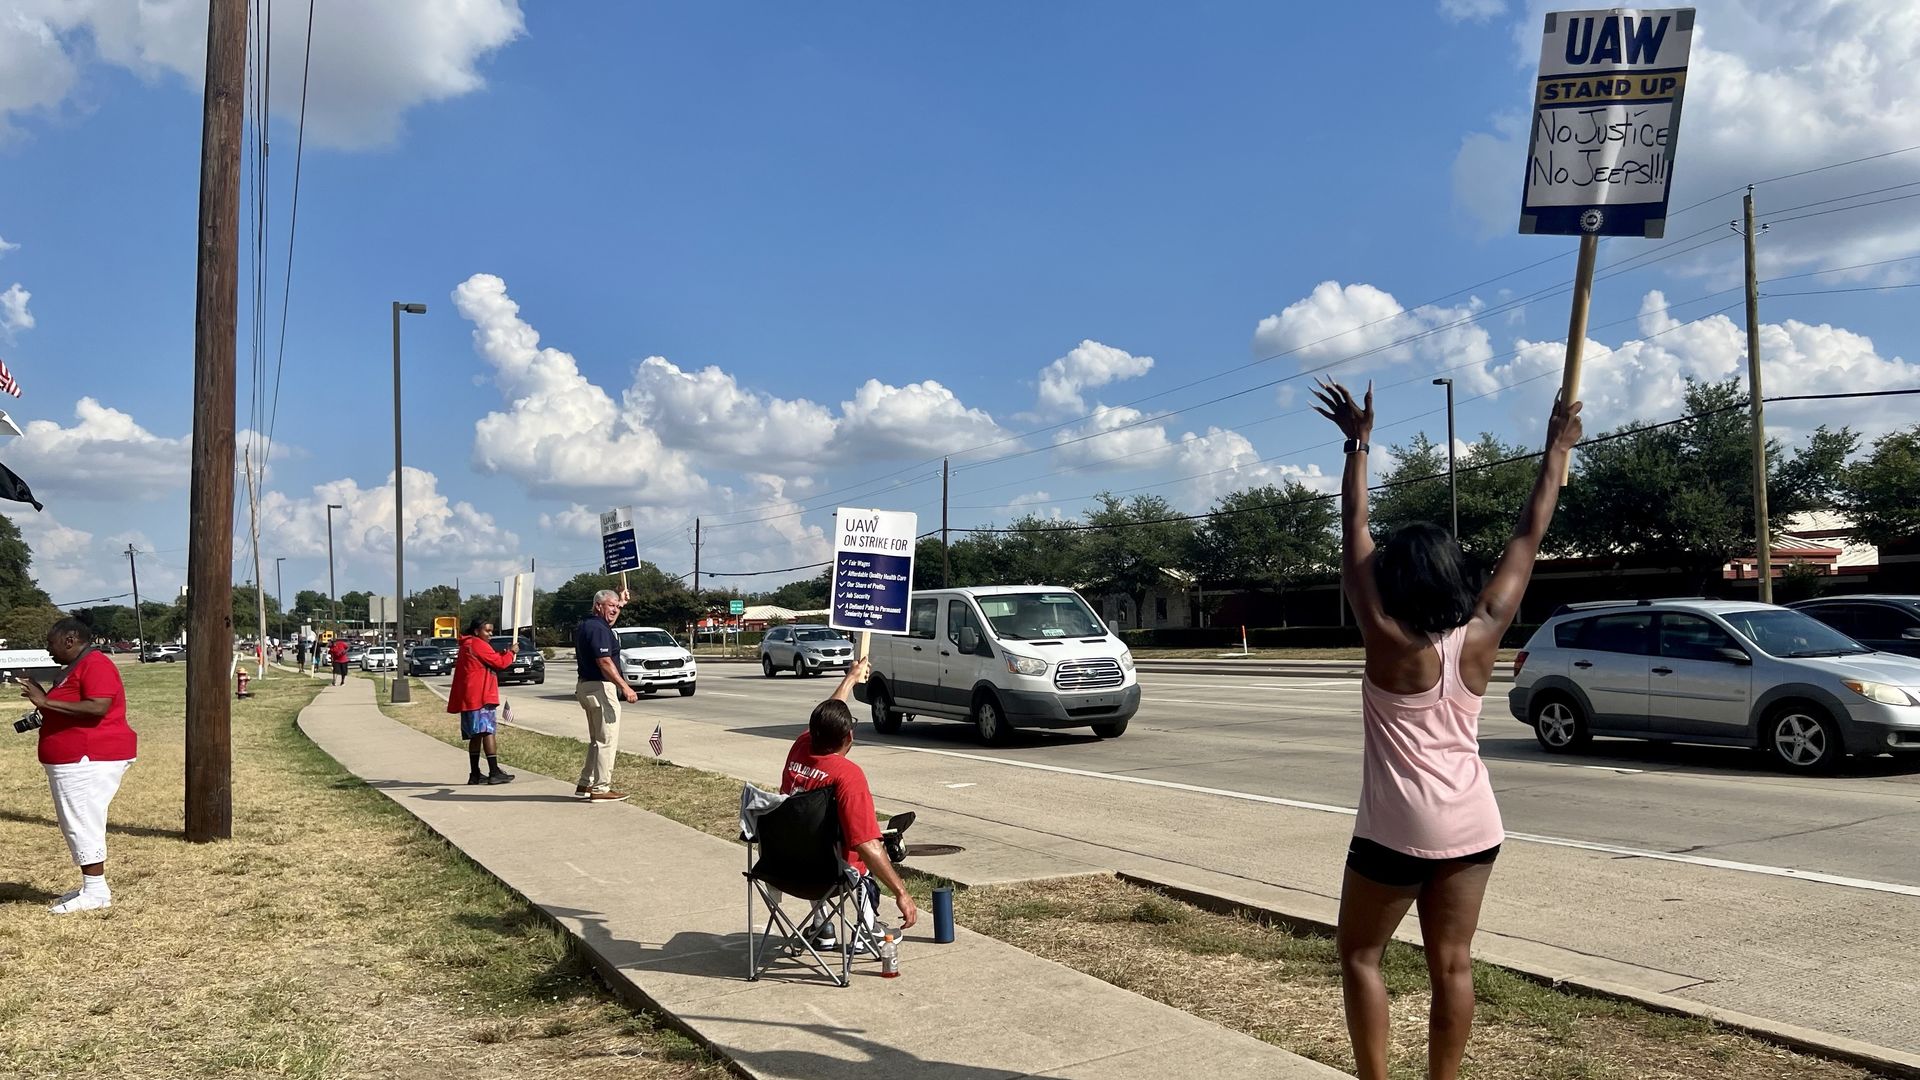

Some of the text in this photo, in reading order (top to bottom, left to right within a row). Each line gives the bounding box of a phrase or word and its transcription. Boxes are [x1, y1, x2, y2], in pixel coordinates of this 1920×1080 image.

[1565, 16, 1671, 65] UAW
[1543, 77, 1677, 100] STAND UP
[1536, 110, 1571, 145] No
[1533, 150, 1569, 186] No
[845, 518, 878, 533] UAW
[843, 534, 908, 551] ON STRIKE FOR
[857, 560, 871, 568] Wages
[847, 570, 869, 578] Affordable
[868, 571, 883, 580] Quality
[883, 573, 897, 581] Health
[855, 581, 867, 589] Share
[872, 583, 886, 591] Profits
[853, 592, 871, 601] Security
[844, 610, 863, 618] Seniority
[870, 611, 883, 620] Temps
[880, 605, 902, 614] Permanent
